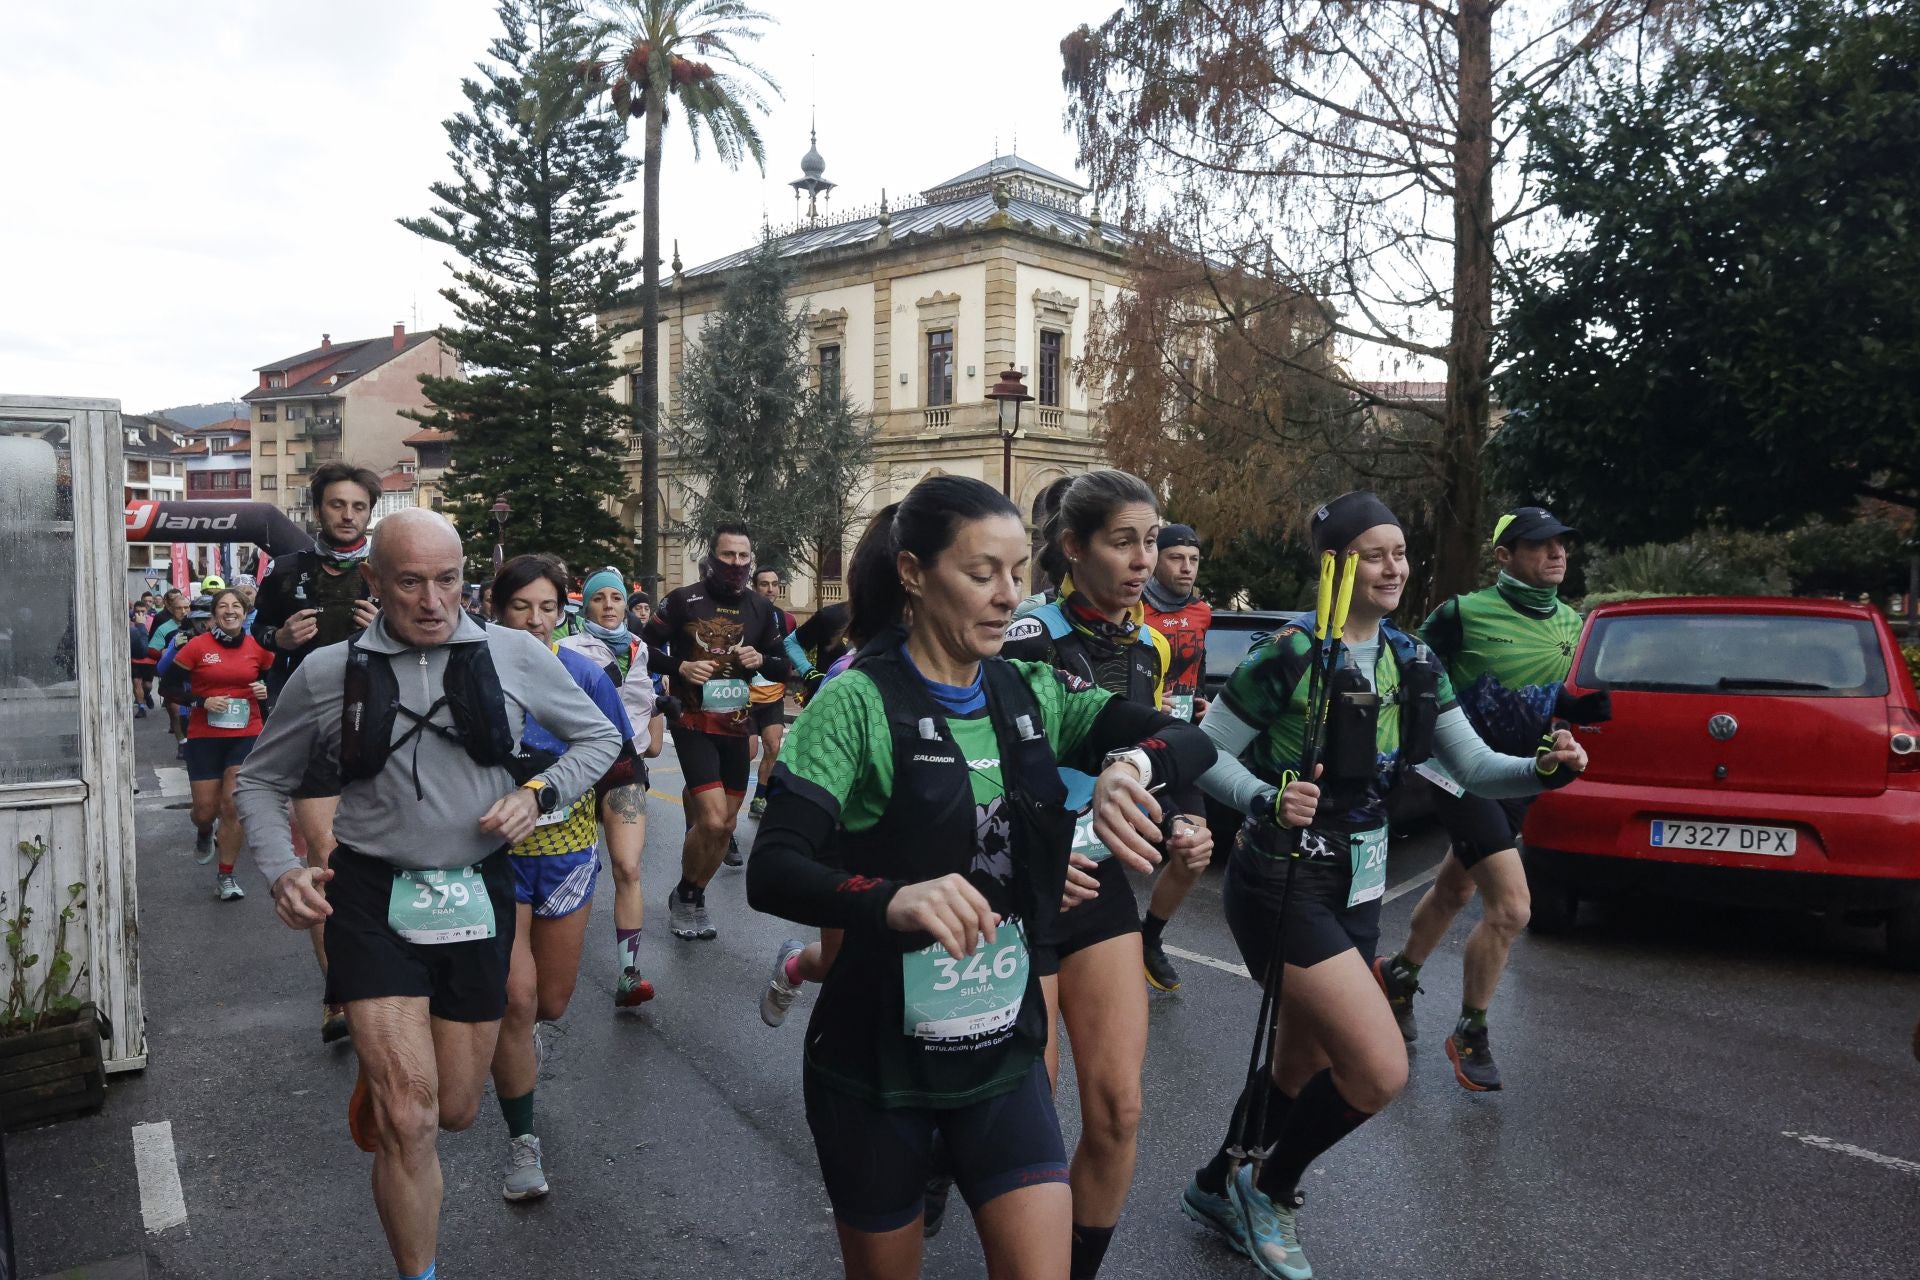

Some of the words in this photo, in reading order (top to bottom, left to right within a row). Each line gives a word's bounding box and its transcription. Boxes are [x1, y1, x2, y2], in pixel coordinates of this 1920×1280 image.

[711, 686, 742, 699] 400
[354, 701, 363, 731] SALOMON
[912, 754, 955, 763] SALOMON
[1668, 824, 1730, 847] 7327
[1740, 828, 1788, 852] DPX
[412, 882, 470, 909] 379
[432, 907, 456, 915] FRAN
[933, 945, 1017, 991] 346
[960, 983, 995, 997] SILVIA
